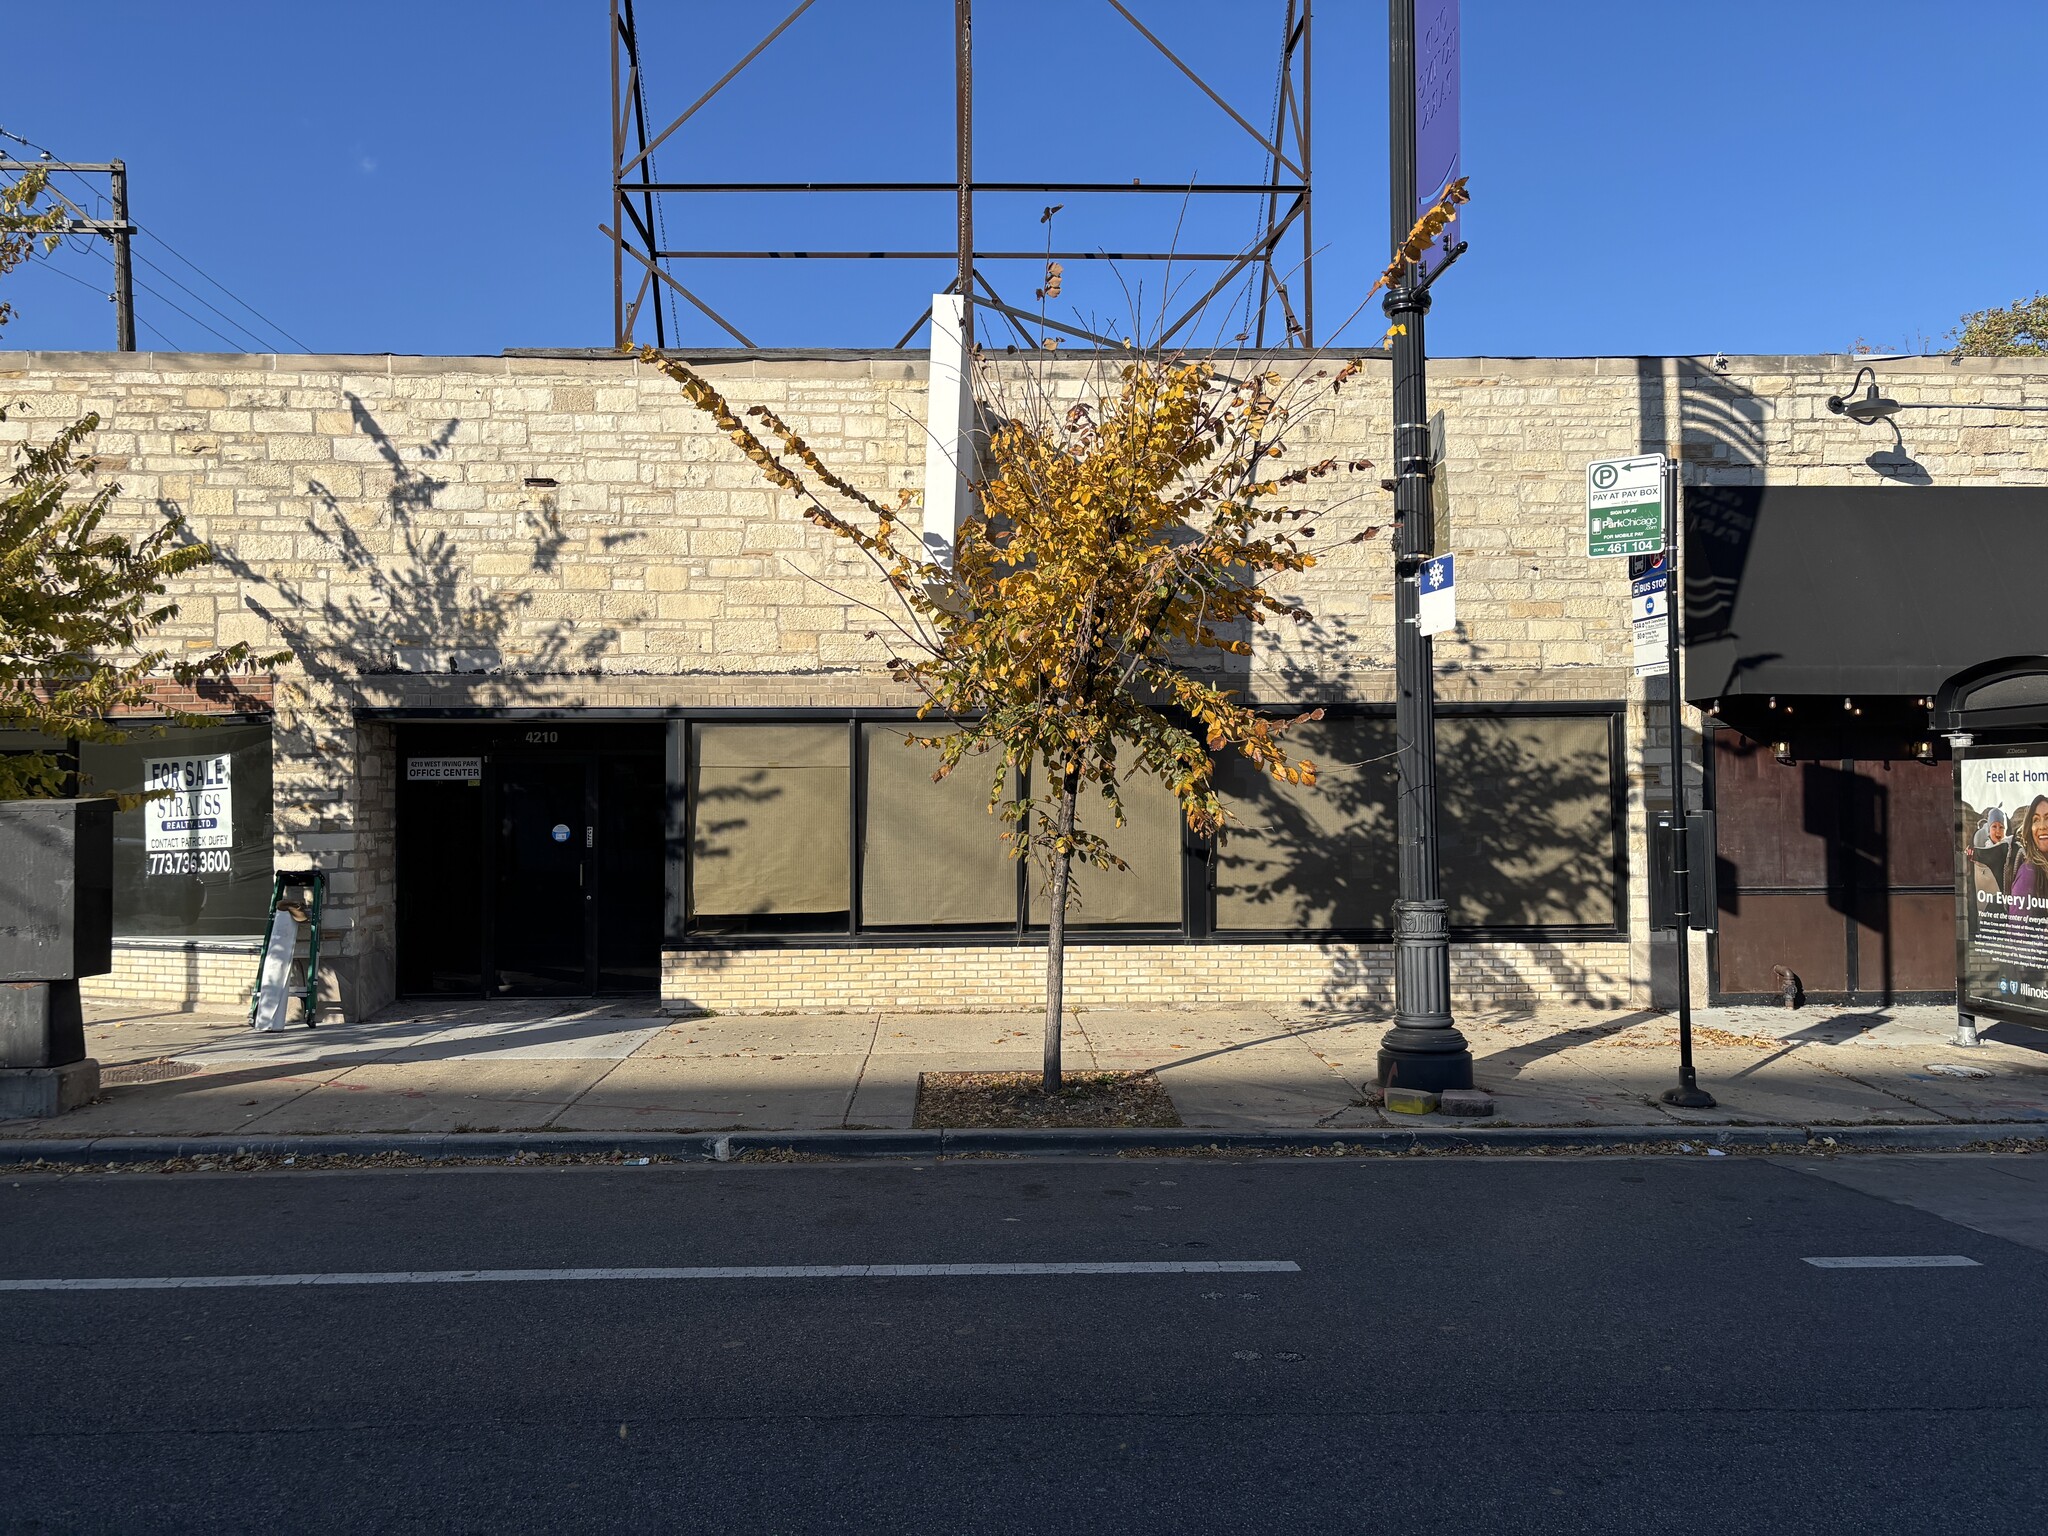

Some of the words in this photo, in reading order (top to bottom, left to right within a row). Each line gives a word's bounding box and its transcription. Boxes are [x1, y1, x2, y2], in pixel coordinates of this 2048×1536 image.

[1600, 469, 1612, 485] P
[1592, 493, 1608, 502] PAY
[1609, 492, 1620, 500] AT
[1621, 490, 1638, 499] PAY
[1639, 488, 1658, 497] BOX
[1602, 516, 1658, 529] ParkChicago
[1607, 542, 1628, 553] 461
[1632, 540, 1653, 551] 104
[1640, 582, 1651, 592] BUS
[1651, 578, 1667, 589] STOP
[525, 731, 558, 743] 4210
[152, 762, 181, 789] FOR
[185, 759, 224, 787] SALE
[409, 769, 441, 777] OFFICE
[443, 768, 480, 777] CENTER
[1986, 770, 2006, 783] Feel
[2009, 771, 2019, 783] at
[157, 794, 221, 819] STRAUSS
[197, 819, 214, 828] LTD.
[150, 838, 179, 849] CONTACT
[181, 837, 207, 847] PATRICK
[208, 835, 229, 846] DUFFY
[149, 850, 231, 875] 773.736.3600
[1977, 890, 1993, 904] On
[1996, 891, 2025, 910] Every
